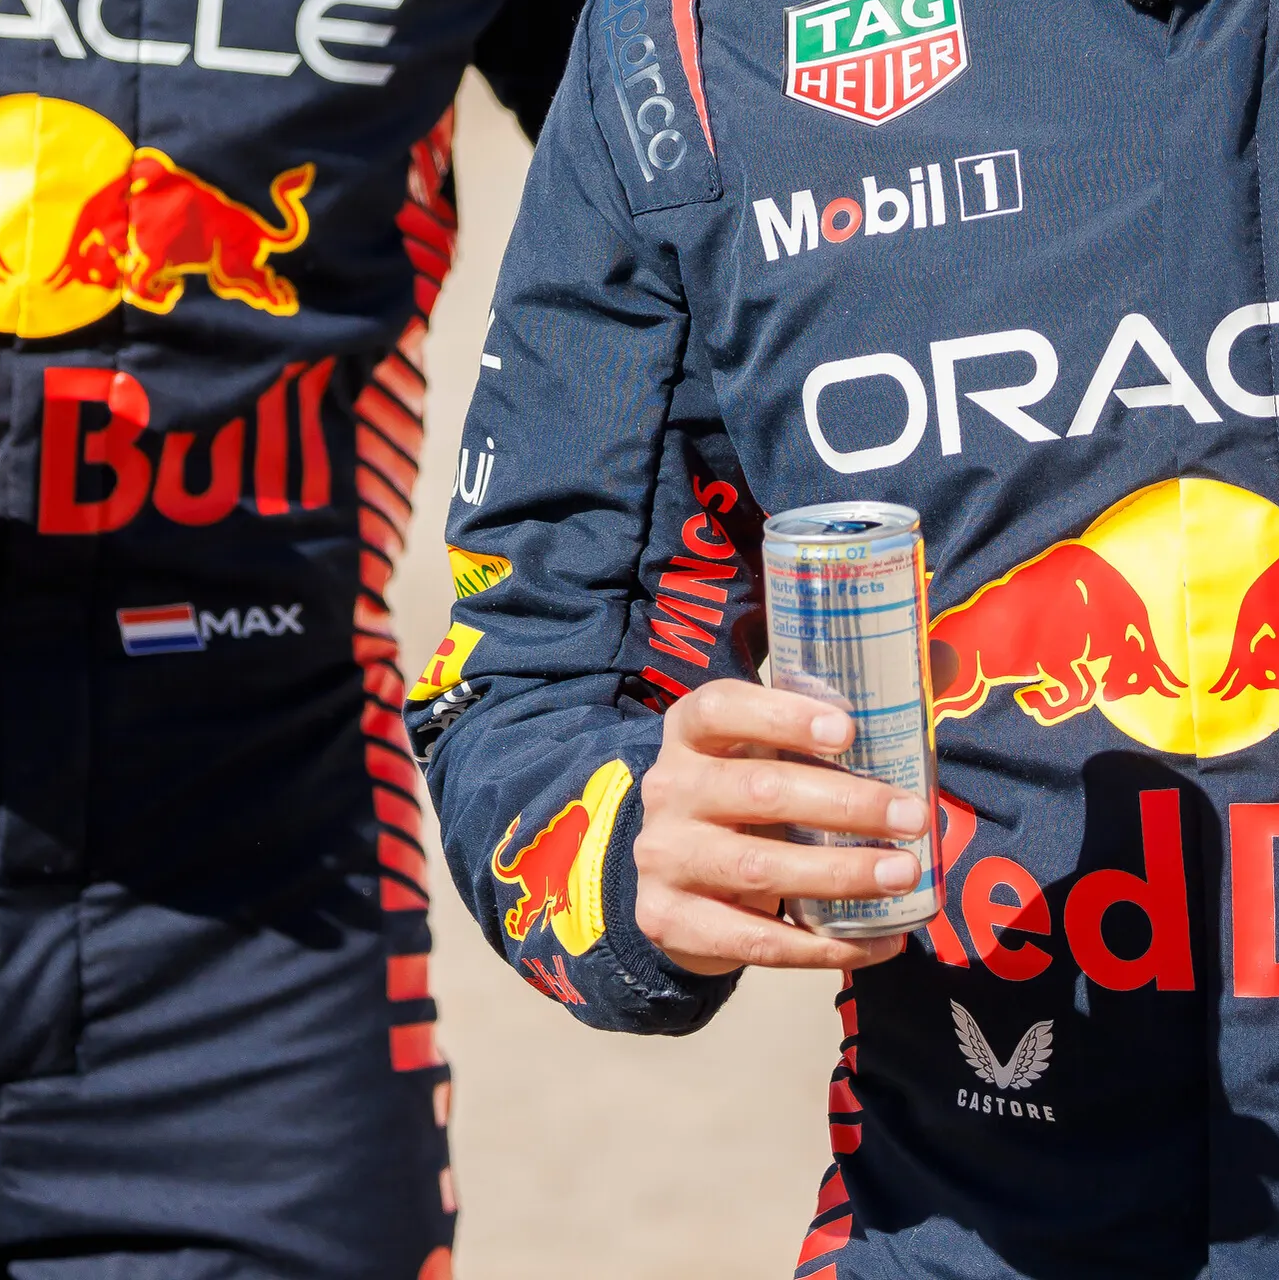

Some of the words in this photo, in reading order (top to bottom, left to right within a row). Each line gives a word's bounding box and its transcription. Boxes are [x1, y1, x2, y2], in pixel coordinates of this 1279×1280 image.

[799, 37, 956, 116] HEUER
[752, 163, 947, 262] Mobil
[37, 356, 336, 535] Bull
[845, 547, 867, 560] OZ
[837, 581, 885, 596] Facts
[201, 603, 304, 638] MAX
[956, 1088, 1056, 1122] CASTORE
